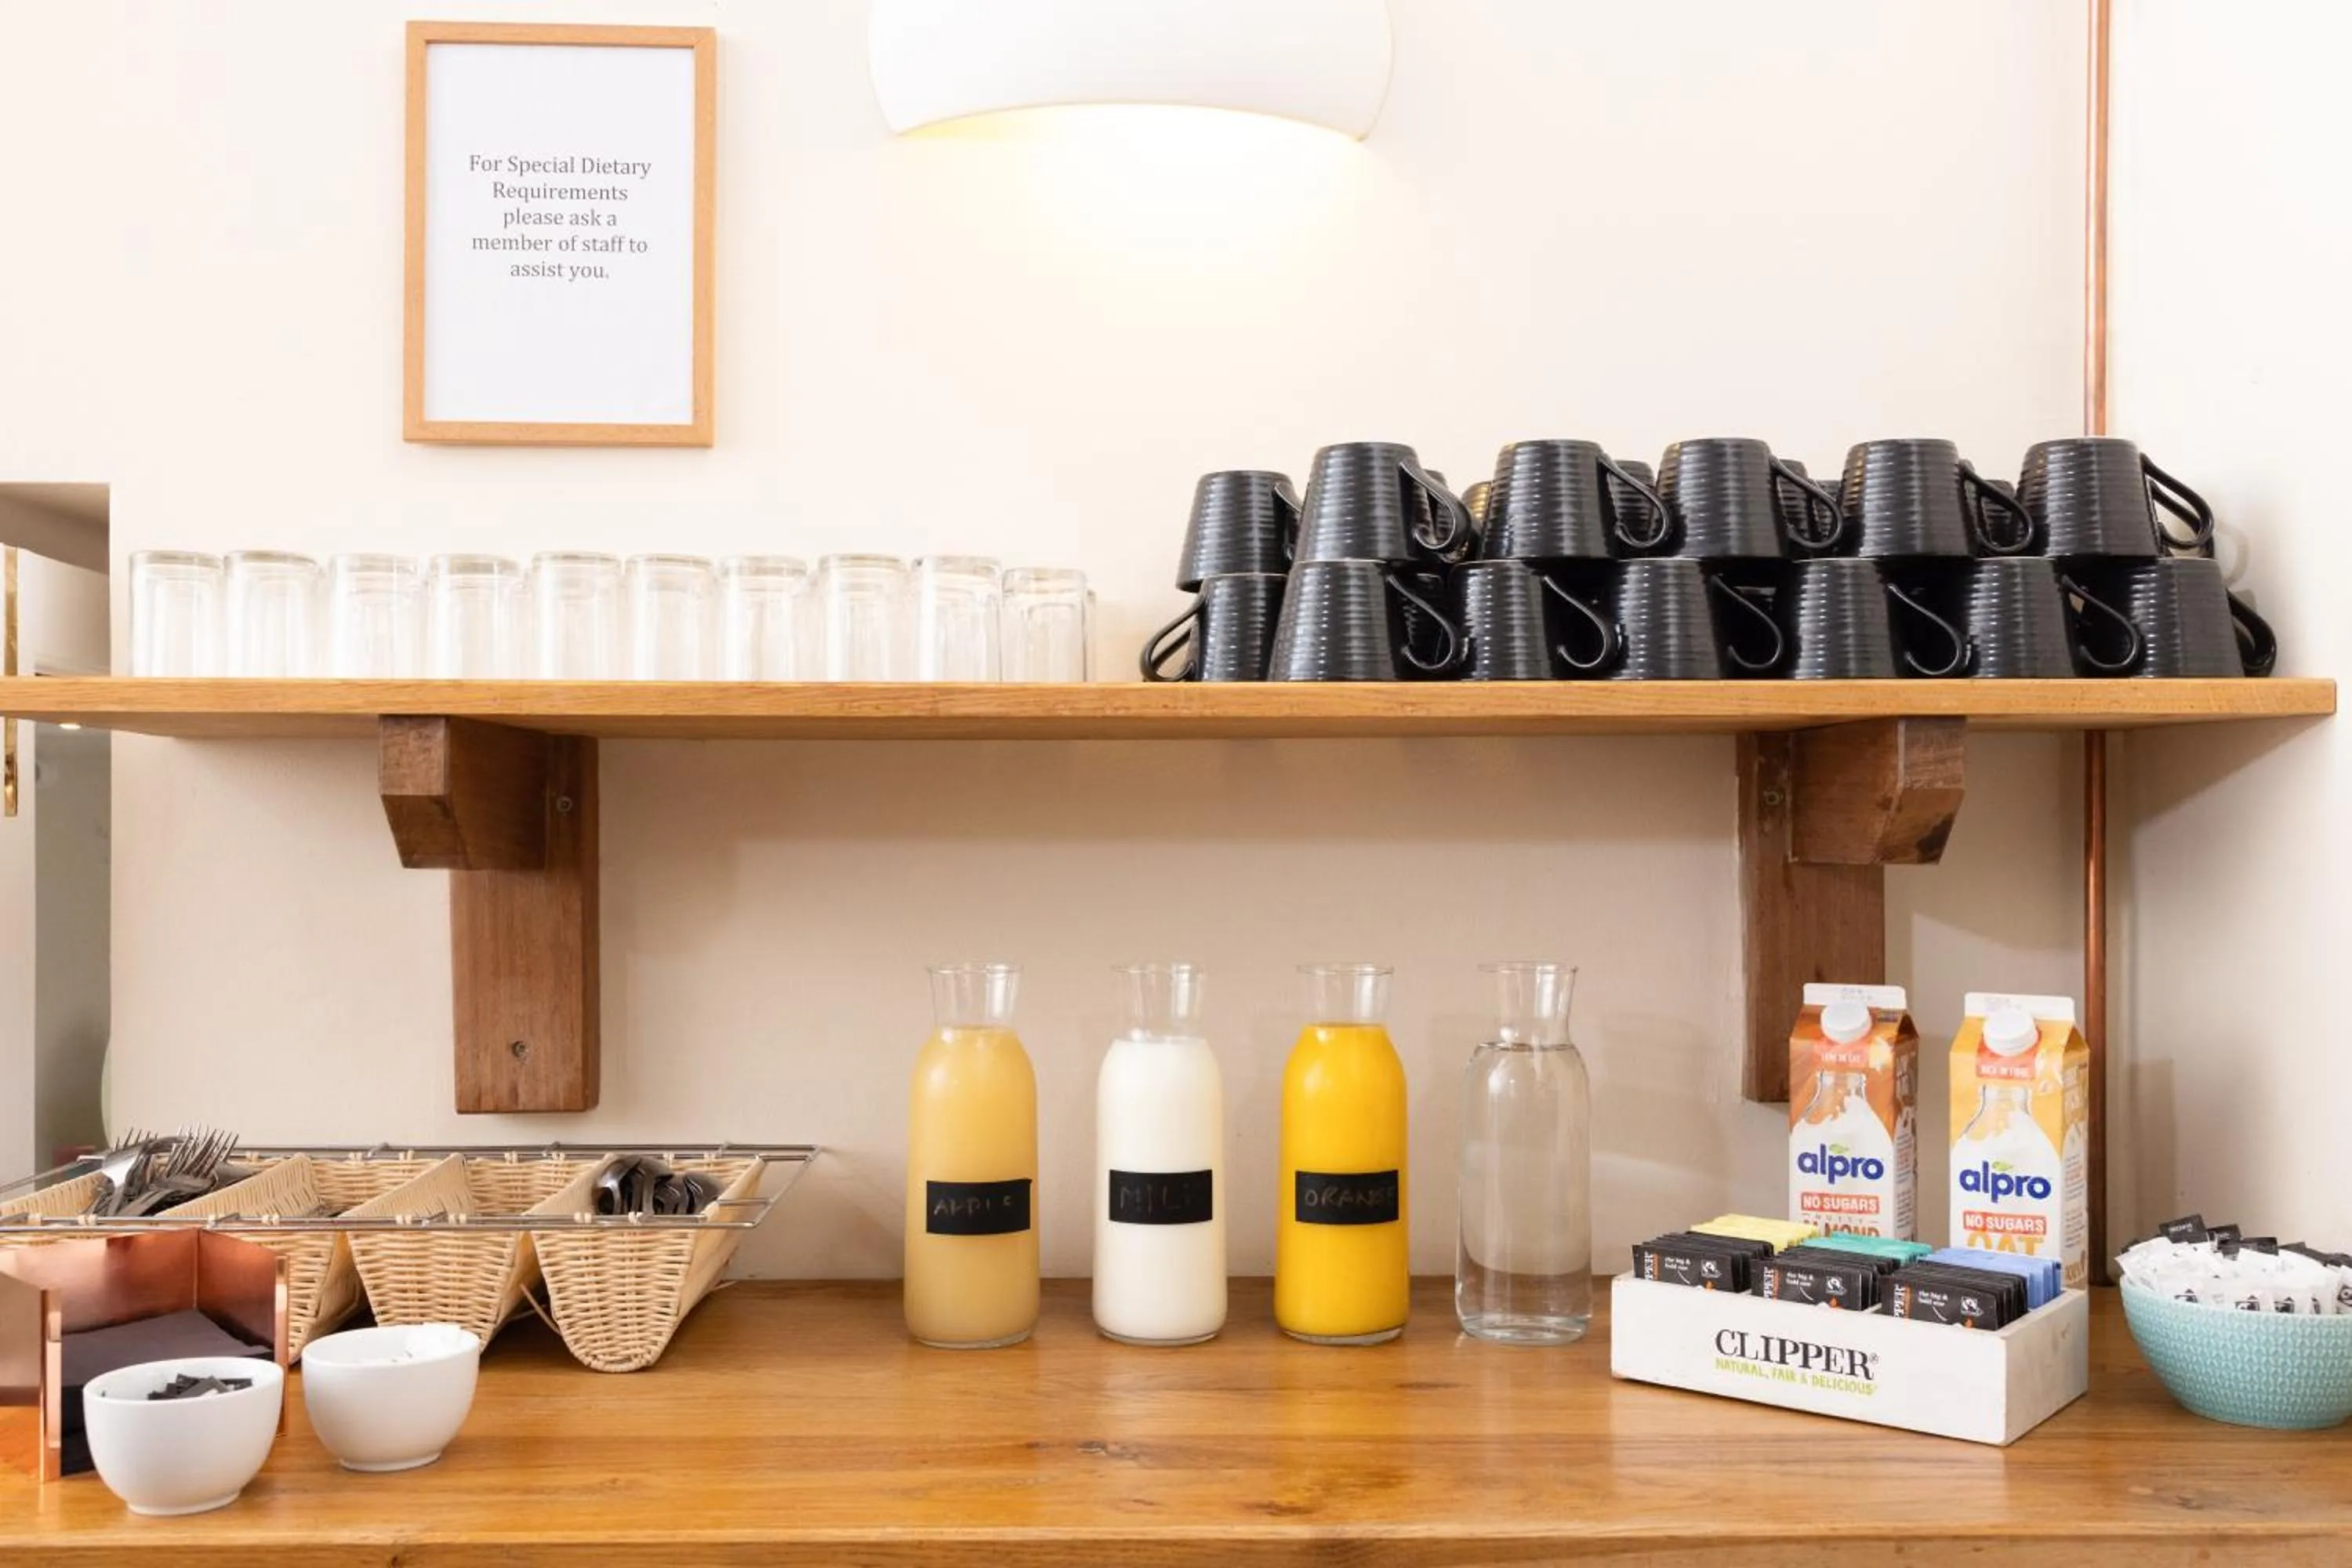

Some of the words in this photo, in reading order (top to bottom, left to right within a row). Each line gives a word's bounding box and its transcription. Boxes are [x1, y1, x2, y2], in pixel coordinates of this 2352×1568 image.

[469, 154, 502, 172] For
[507, 156, 575, 176] Special
[582, 158, 652, 180] Dietary
[493, 182, 628, 203] Requirements
[503, 208, 564, 229] please
[569, 209, 601, 227] ask
[607, 214, 618, 226] a
[472, 234, 552, 251] member
[558, 235, 579, 252] of
[583, 236, 626, 252] staff
[630, 238, 648, 253] to
[510, 261, 564, 278] assist
[569, 265, 609, 282] you.
[1798, 1143, 1884, 1185] alpro
[1958, 1160, 2052, 1203] alpro
[1120, 1183, 1195, 1214] MIL
[1802, 1195, 1820, 1208] NO
[1823, 1196, 1878, 1211] SUGARS
[1965, 1214, 1983, 1227] NO
[1986, 1216, 2044, 1232] SUGARS
[1715, 1357, 1769, 1380] NATURAL,
[1771, 1367, 1797, 1383] FAIR
[1799, 1374, 1808, 1385] &
[1811, 1374, 1876, 1396] DELICIOUS
